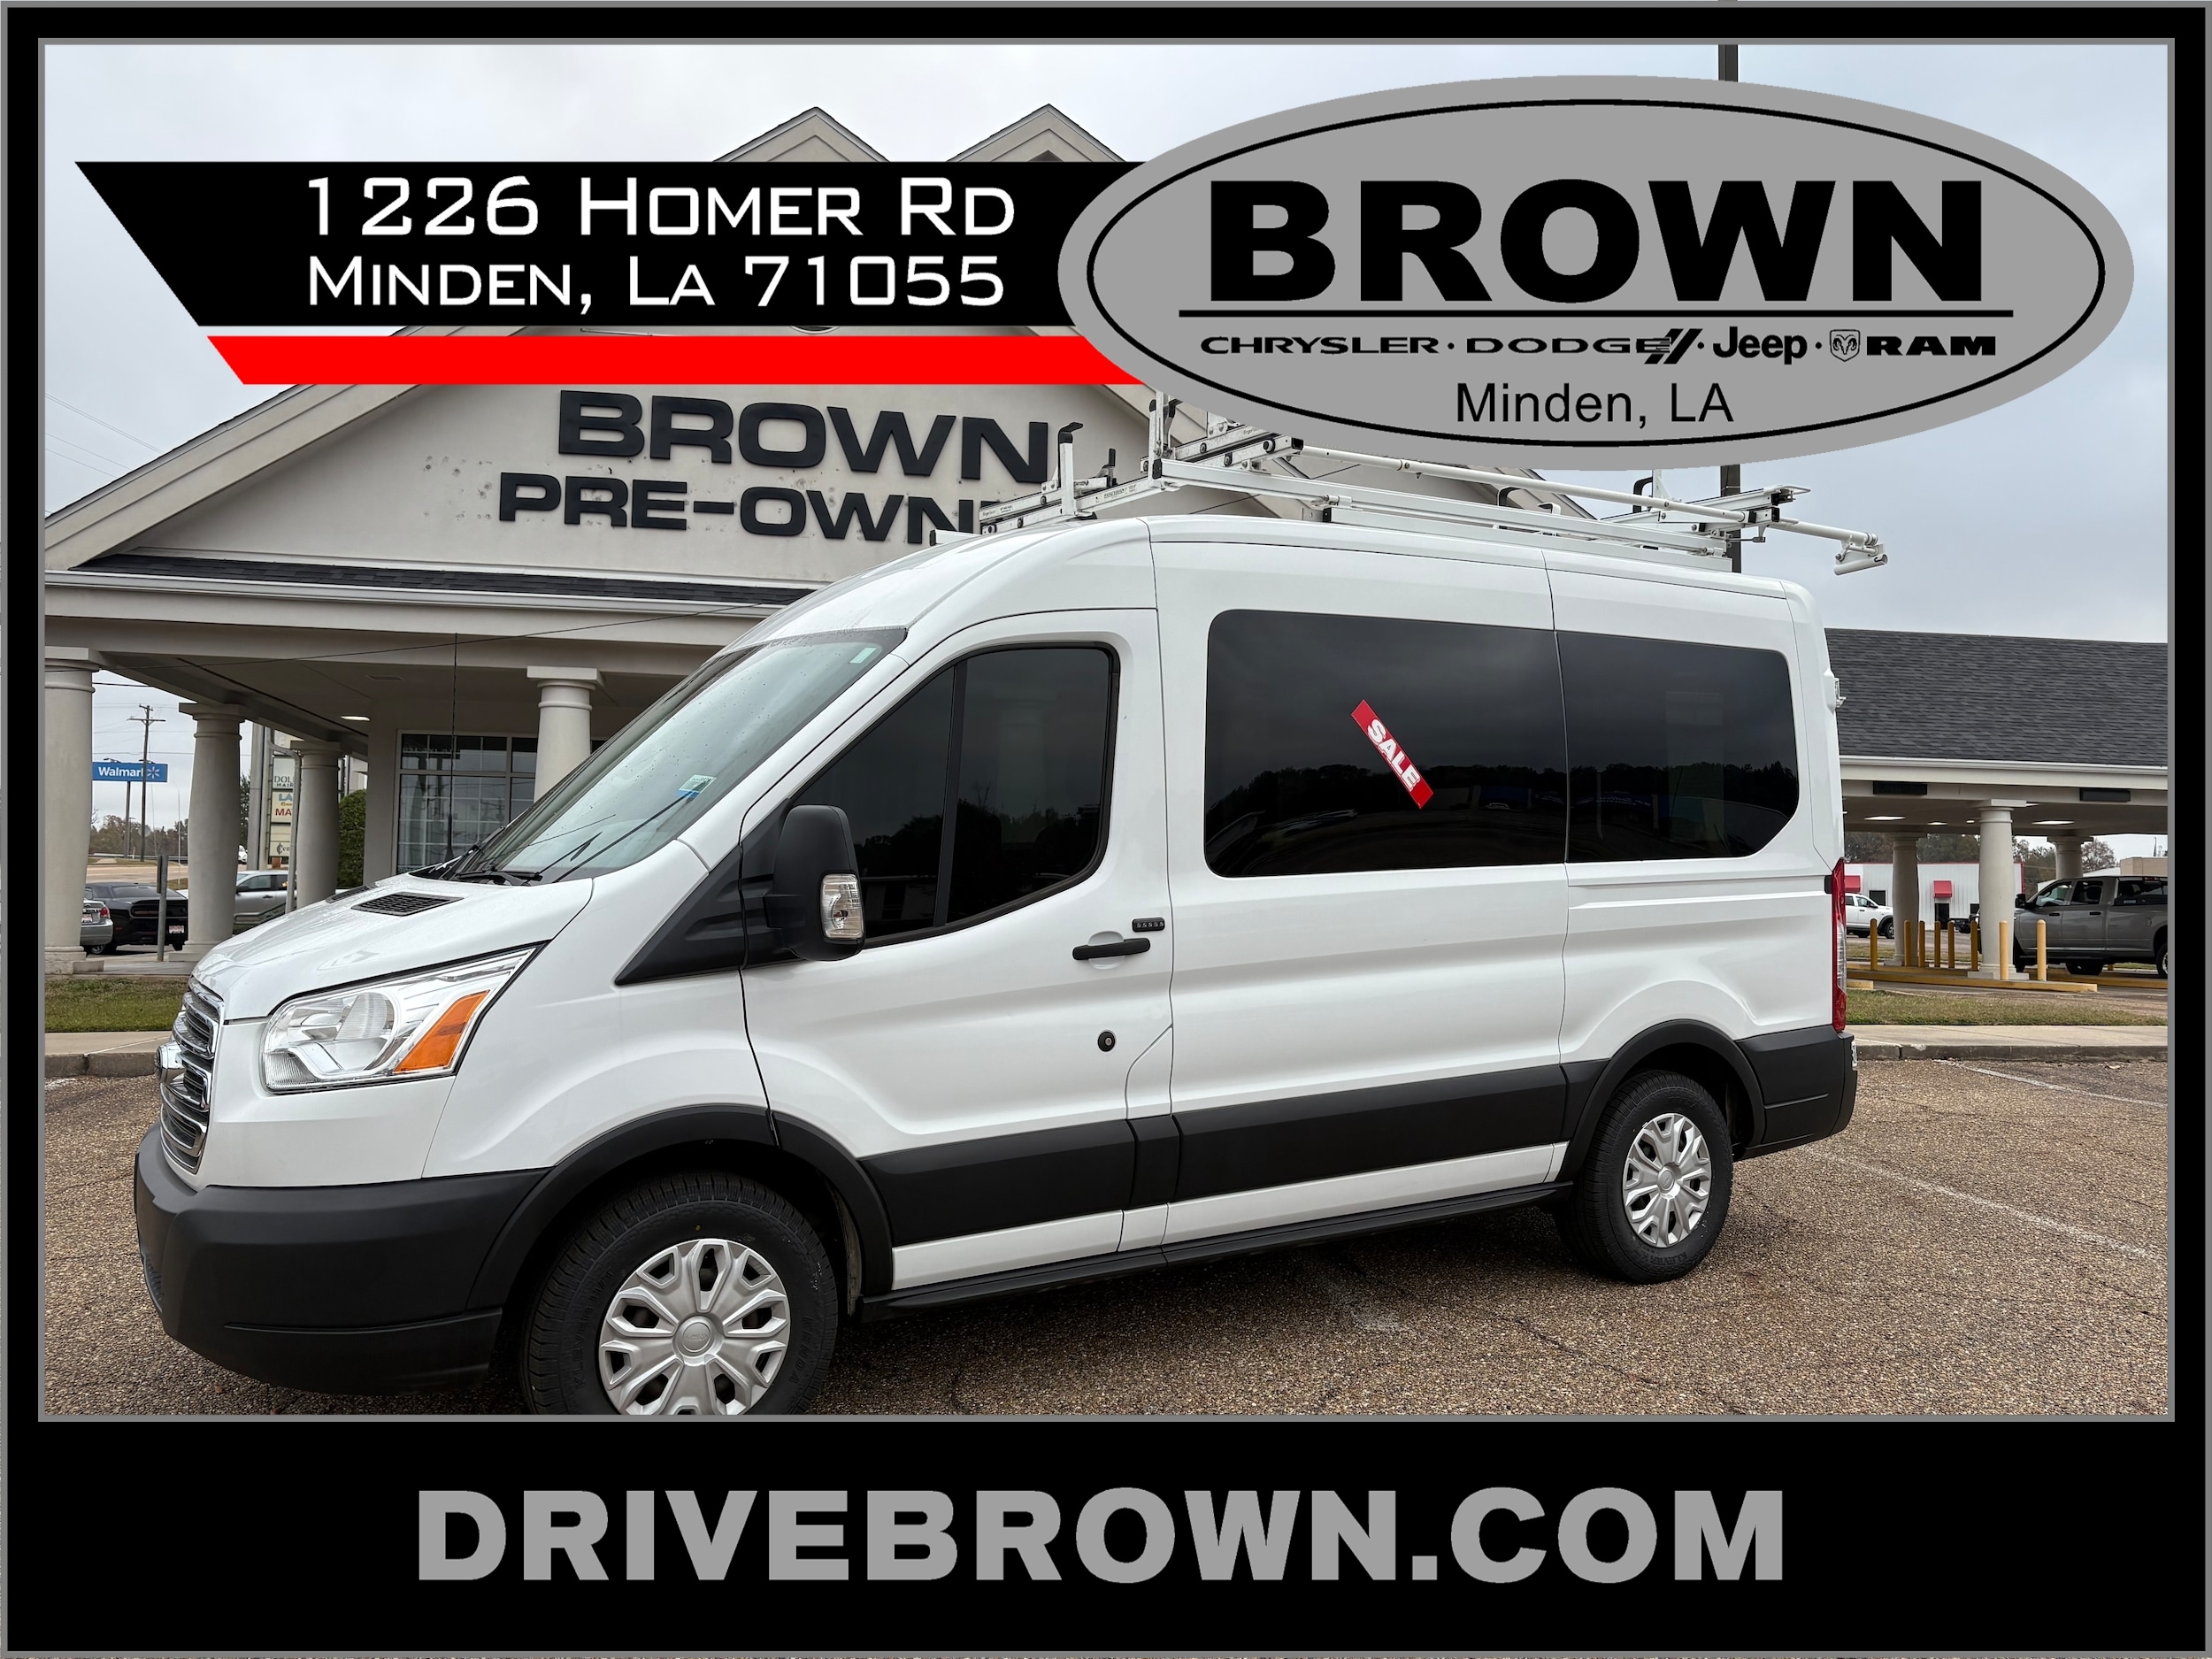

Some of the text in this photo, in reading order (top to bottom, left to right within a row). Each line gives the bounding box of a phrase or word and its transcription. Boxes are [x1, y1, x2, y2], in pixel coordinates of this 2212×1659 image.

[558, 390, 1048, 484] BROWN
[499, 472, 1002, 544] PRE-OWN
[1367, 718, 1422, 792] SALE
[788, 1315, 814, 1385] KENDA
